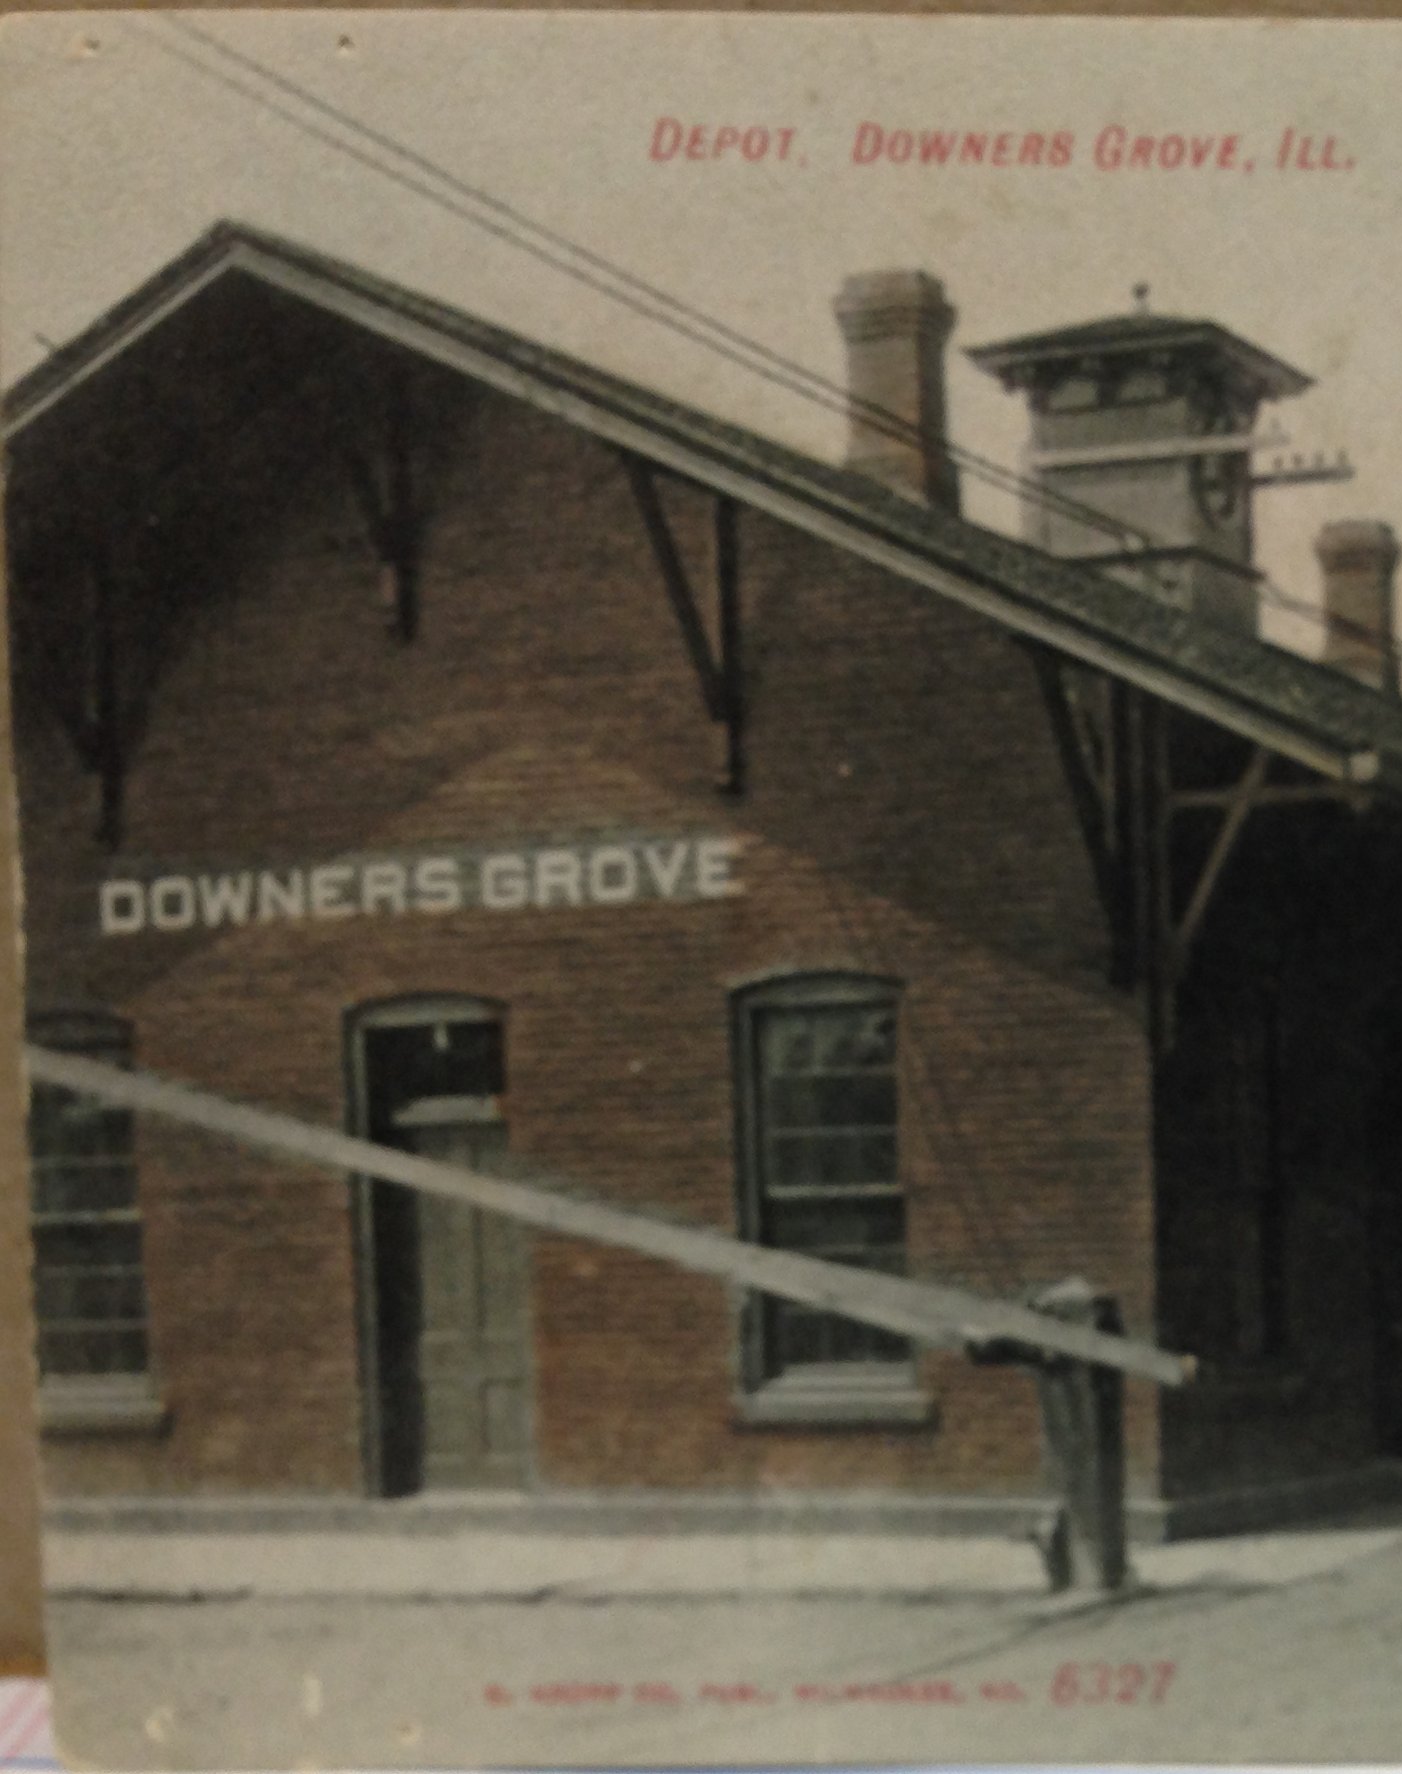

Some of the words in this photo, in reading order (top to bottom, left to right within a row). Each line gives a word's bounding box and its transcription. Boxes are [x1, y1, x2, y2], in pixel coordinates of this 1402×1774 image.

[851, 120, 1075, 167] DOWNERS
[100, 857, 463, 936] DOWNERS
[480, 838, 747, 909] GROVE
